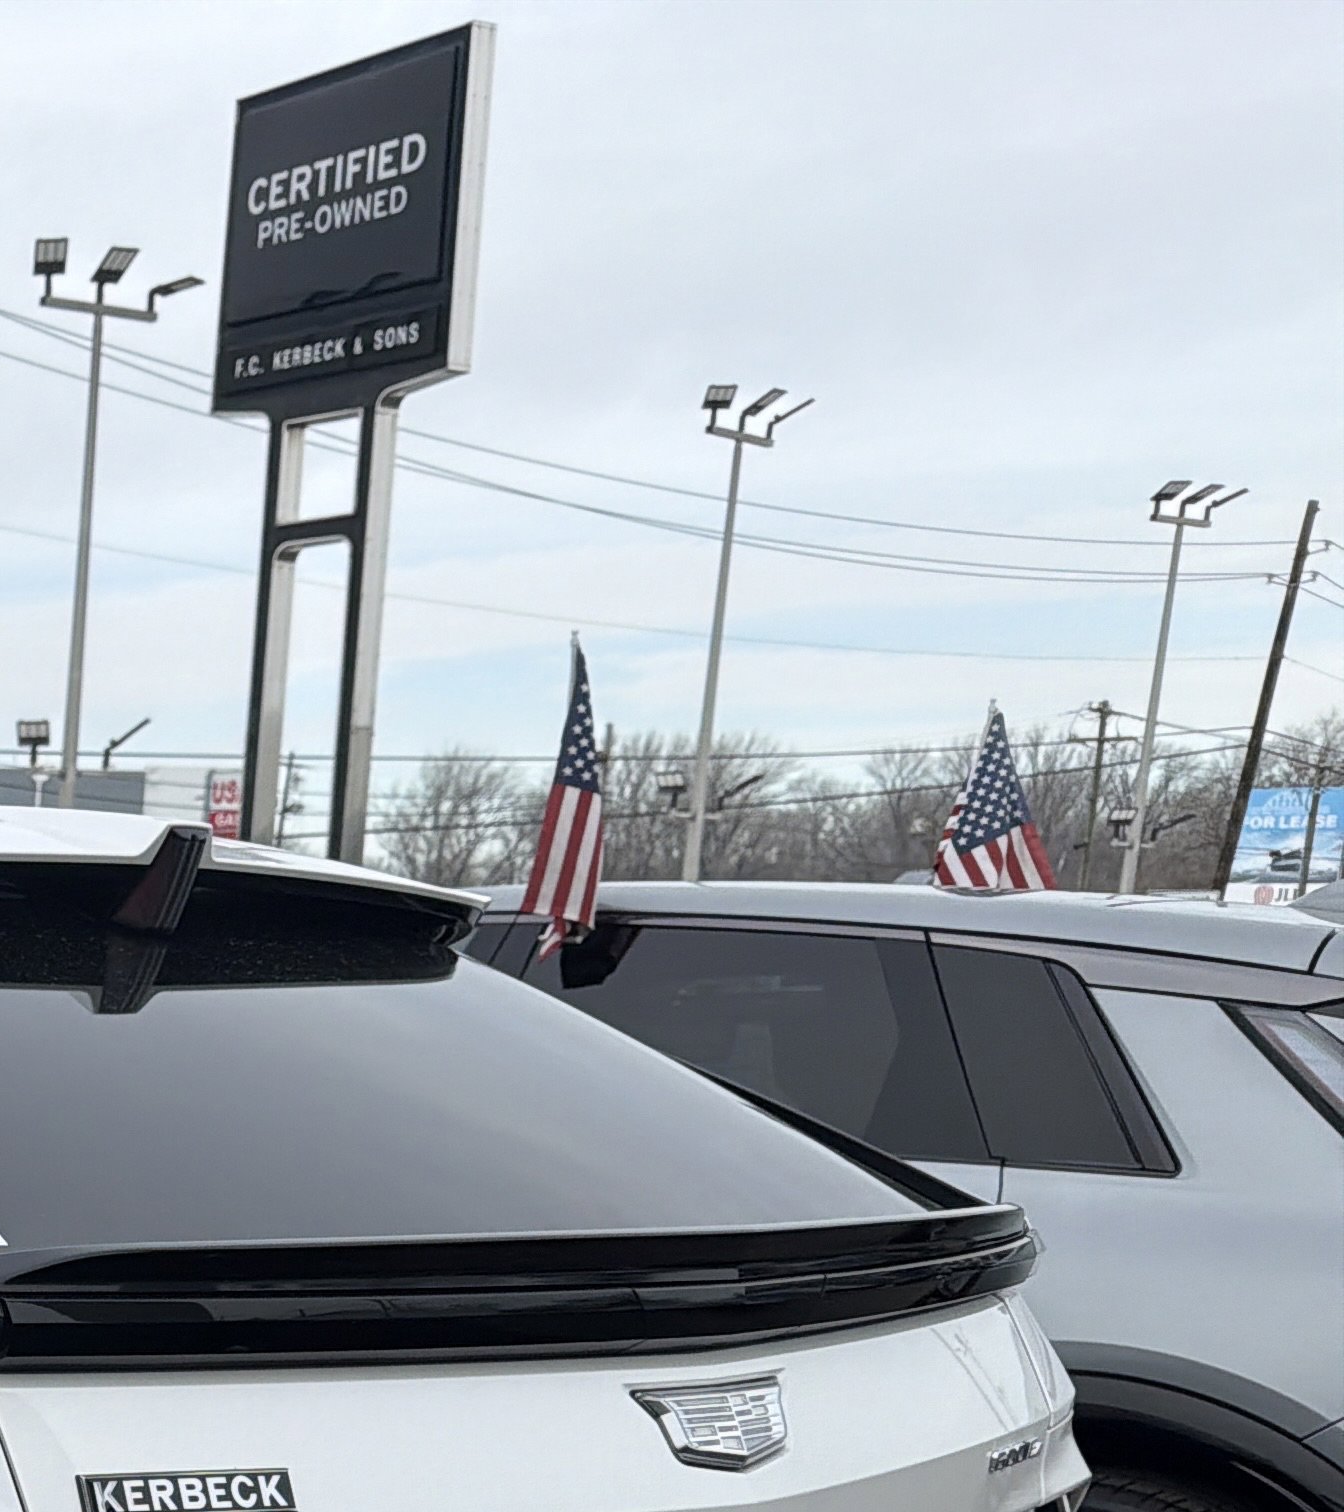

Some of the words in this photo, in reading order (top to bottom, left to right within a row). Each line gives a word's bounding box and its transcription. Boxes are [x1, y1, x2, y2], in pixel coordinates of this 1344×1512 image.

[247, 133, 427, 215] CERTIFIED
[257, 185, 408, 249] PRE-OWNED
[234, 355, 264, 378] F.C.
[272, 337, 347, 371] KERBECK
[353, 337, 364, 355] &
[373, 322, 421, 350] SONS
